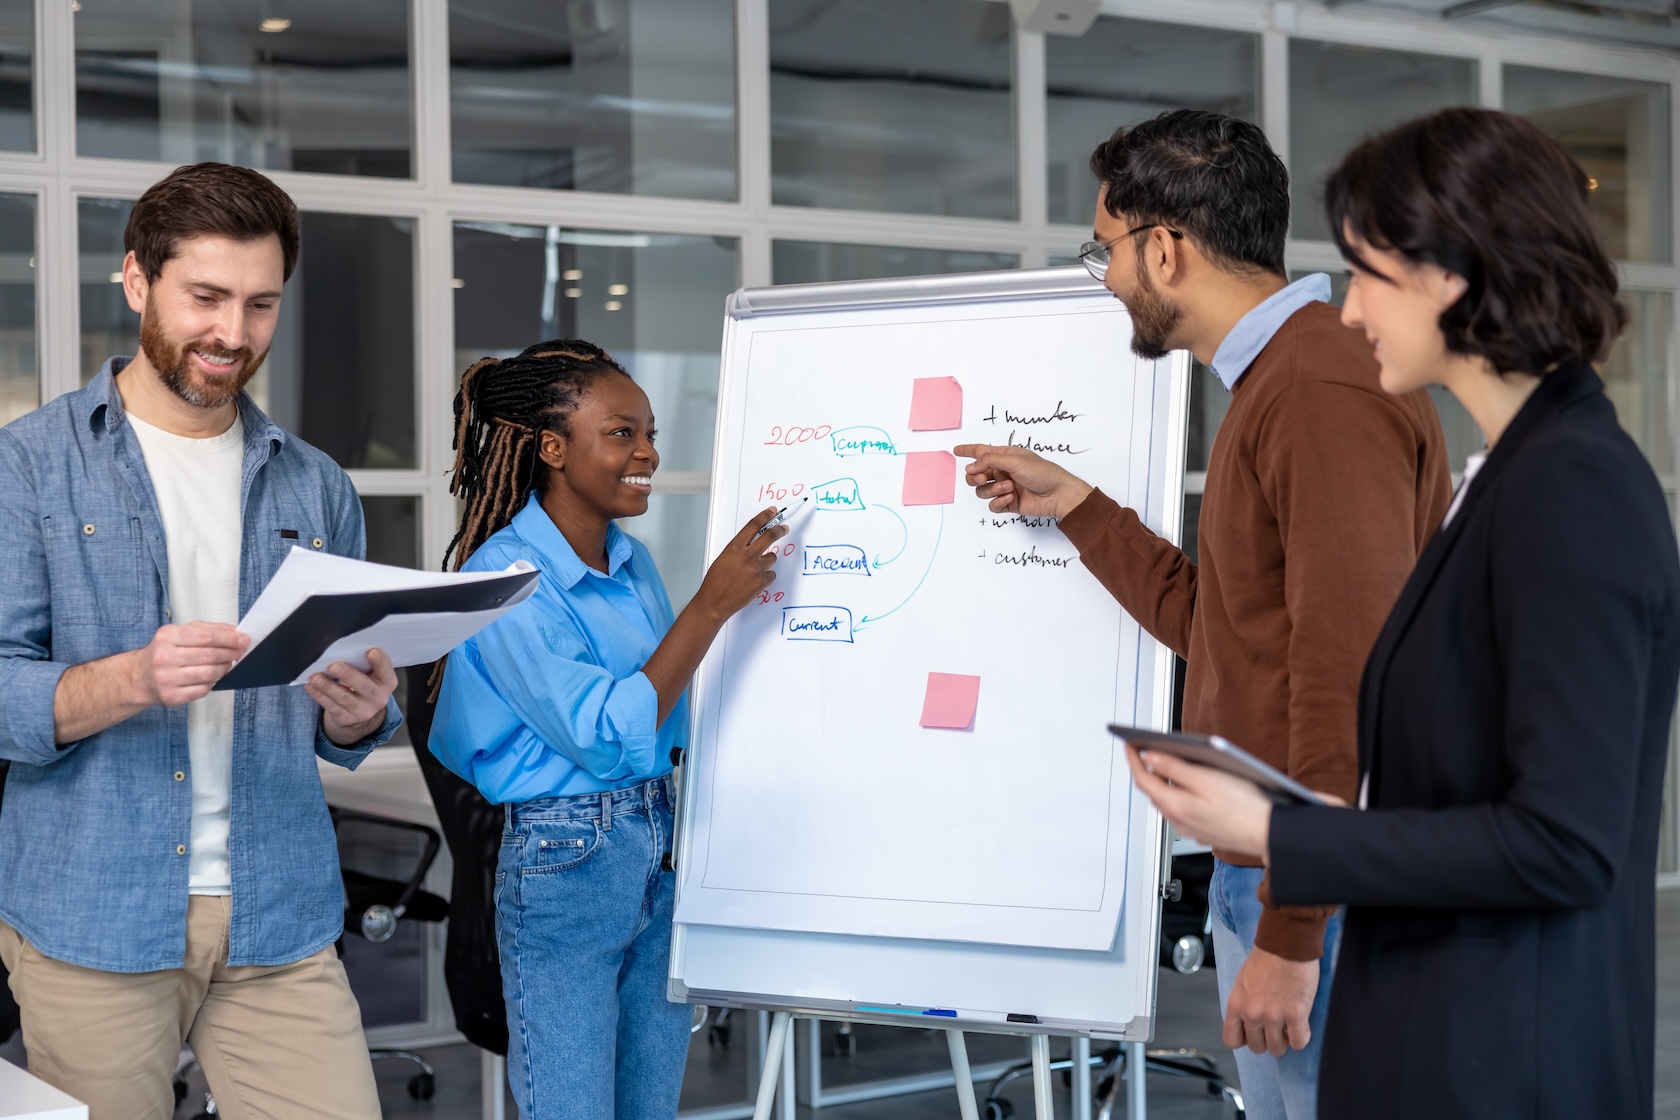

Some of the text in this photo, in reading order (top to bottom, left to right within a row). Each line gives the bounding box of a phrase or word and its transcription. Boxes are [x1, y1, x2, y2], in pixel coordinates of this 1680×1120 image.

[764, 425, 831, 446] 2000
[758, 482, 805, 503] 1500
[819, 489, 857, 505] total
[994, 545, 1078, 568] customer
[789, 616, 845, 632] Current
